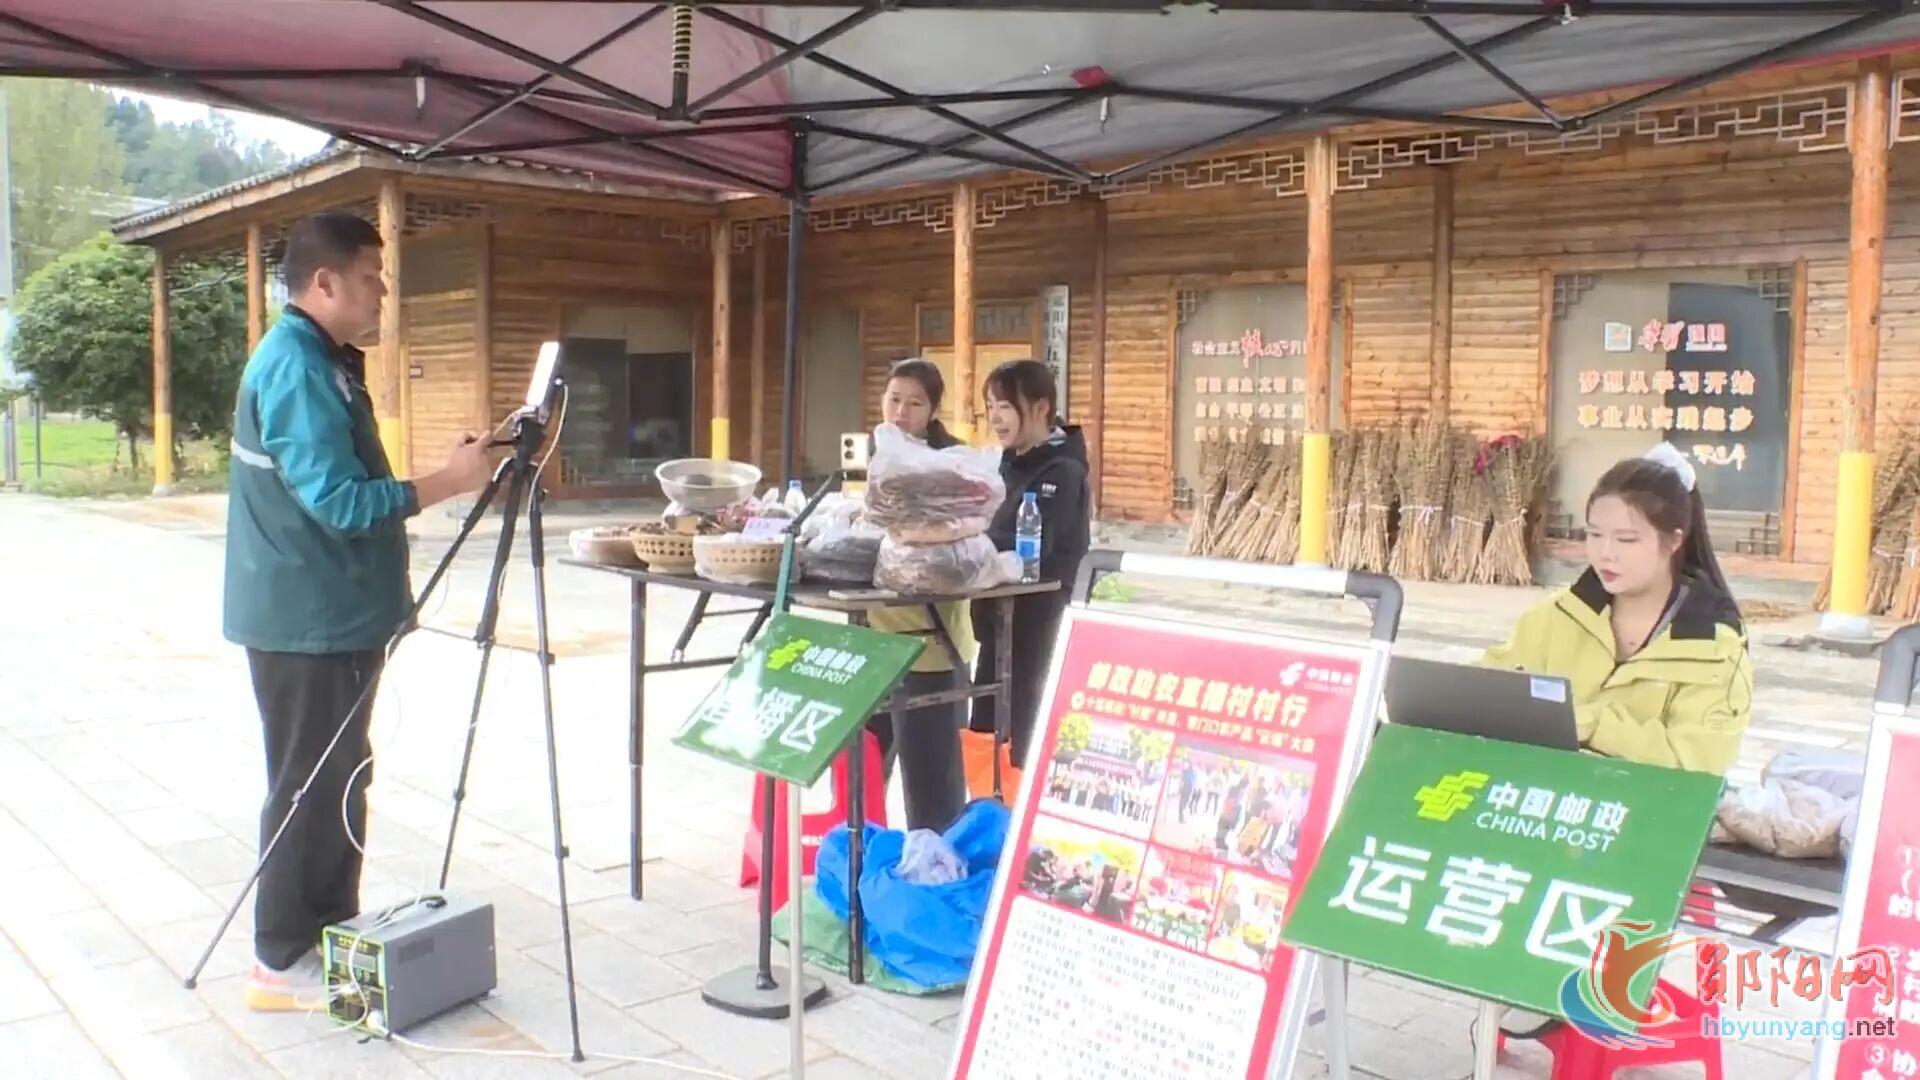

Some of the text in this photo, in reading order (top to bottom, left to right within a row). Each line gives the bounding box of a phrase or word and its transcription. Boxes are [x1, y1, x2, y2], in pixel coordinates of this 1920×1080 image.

[1579, 369, 1756, 396] 梦想从学习开始
[1577, 404, 1754, 432] 事业从实践起步
[790, 662, 853, 685] CHINA POST
[802, 644, 868, 675] 中国邮政
[1086, 660, 1310, 728] 邮政助农直播村村行
[1486, 781, 1630, 835] 中国邮政
[1475, 811, 1616, 854] CHINA POST
[1328, 836, 1634, 972] 运营区
